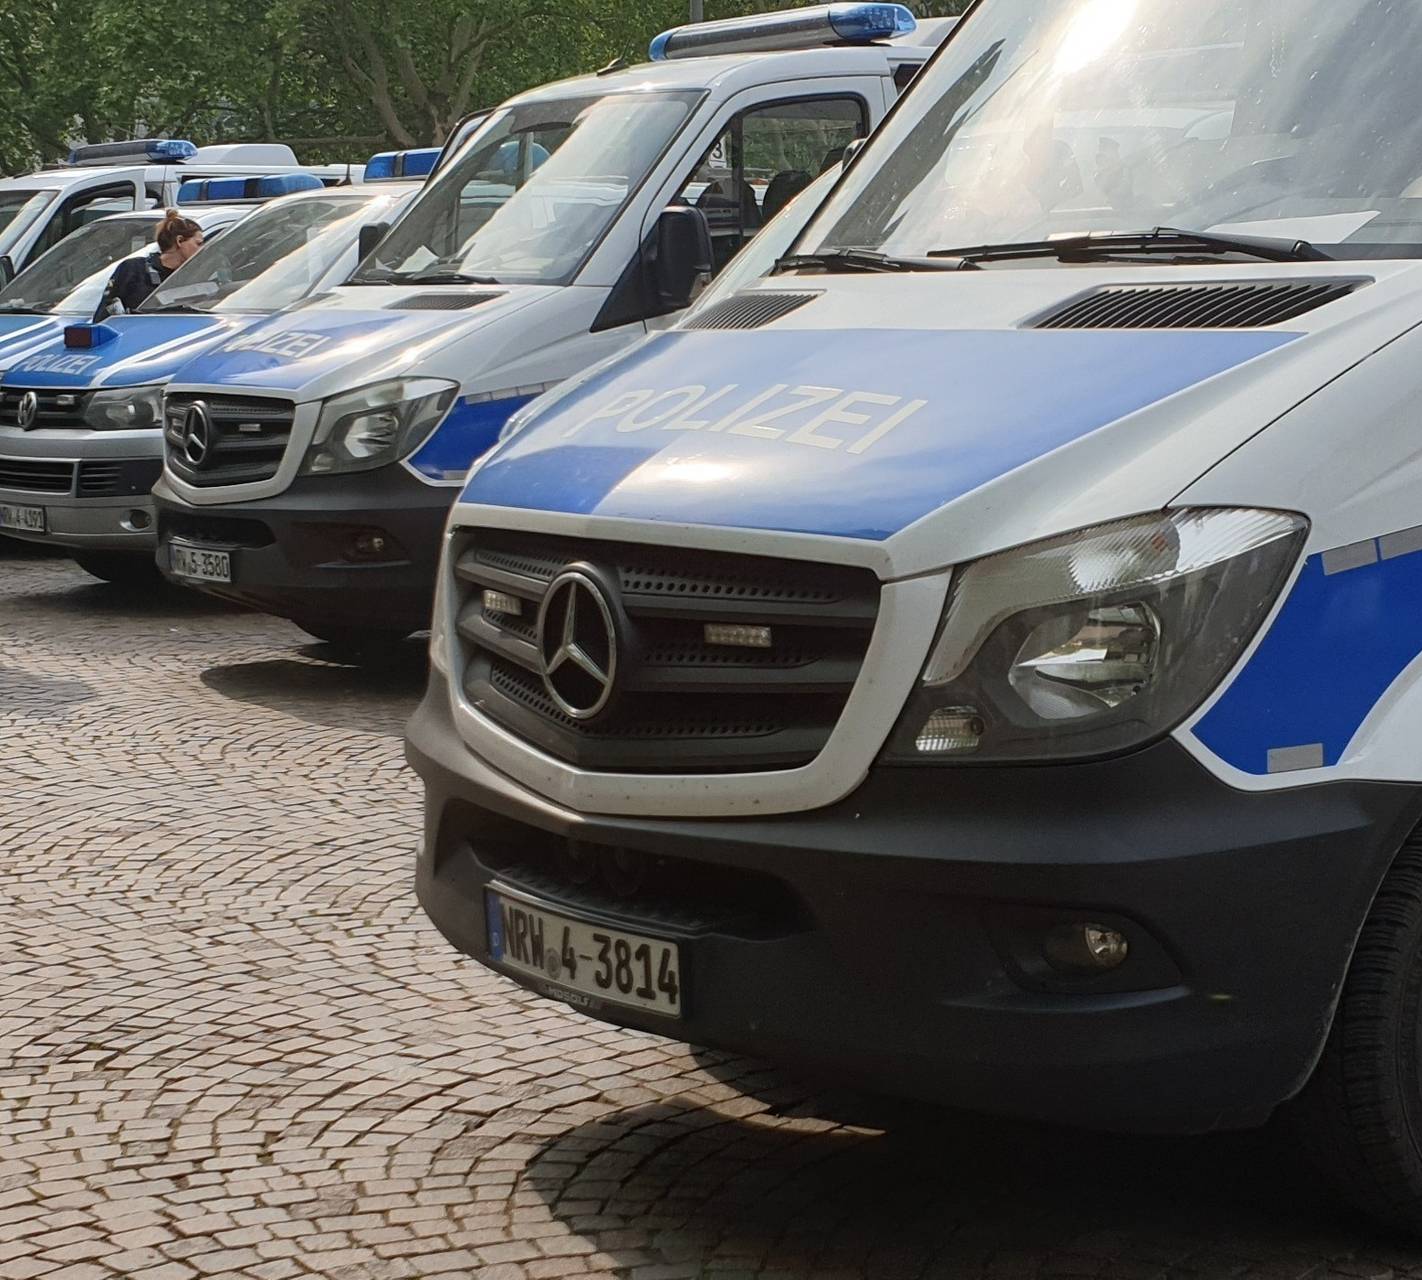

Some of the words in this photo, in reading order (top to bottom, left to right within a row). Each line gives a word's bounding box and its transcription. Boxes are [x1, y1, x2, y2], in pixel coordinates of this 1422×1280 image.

[561, 383, 929, 454] POLIZEI
[504, 906, 544, 969] NRW
[561, 926, 678, 1004] 4-3814
